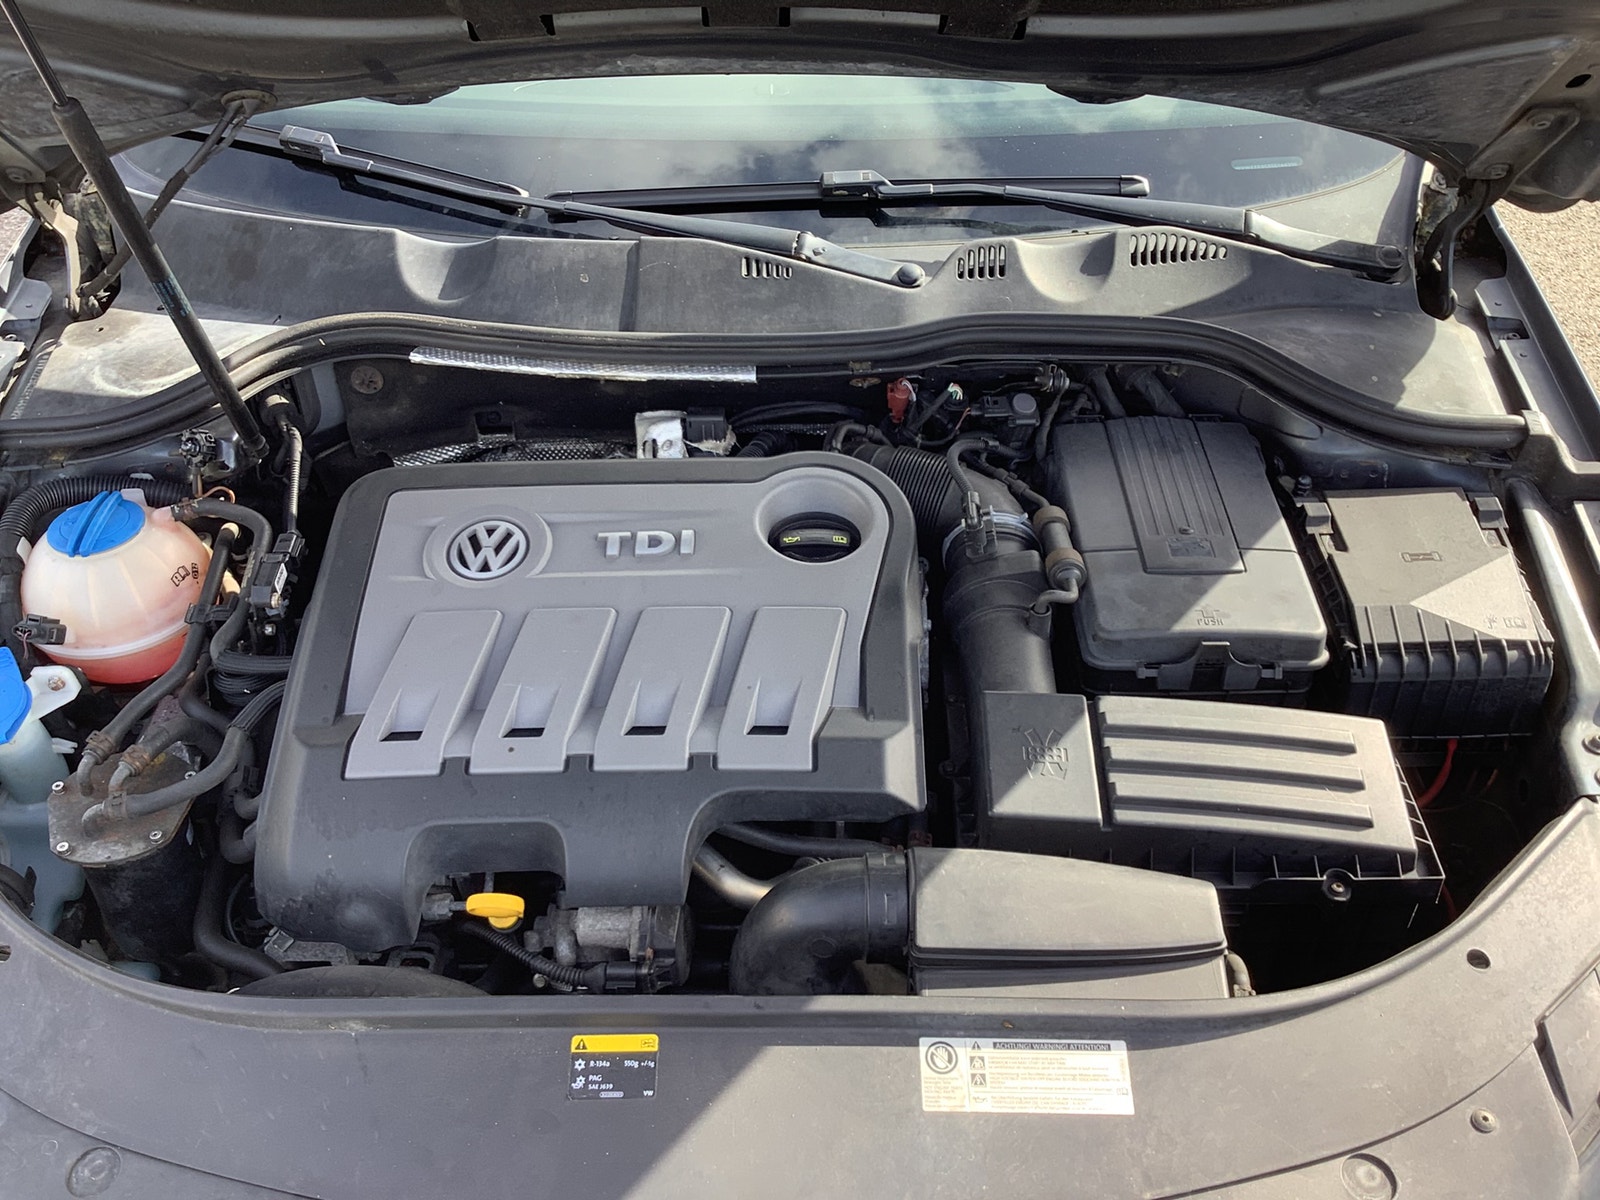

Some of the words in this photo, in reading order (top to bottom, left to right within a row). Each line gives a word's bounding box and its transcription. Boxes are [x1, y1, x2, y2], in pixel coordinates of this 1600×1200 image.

[597, 529, 696, 557] TDI
[1196, 618, 1224, 626] PUSH
[589, 1060, 610, 1068] R-134a
